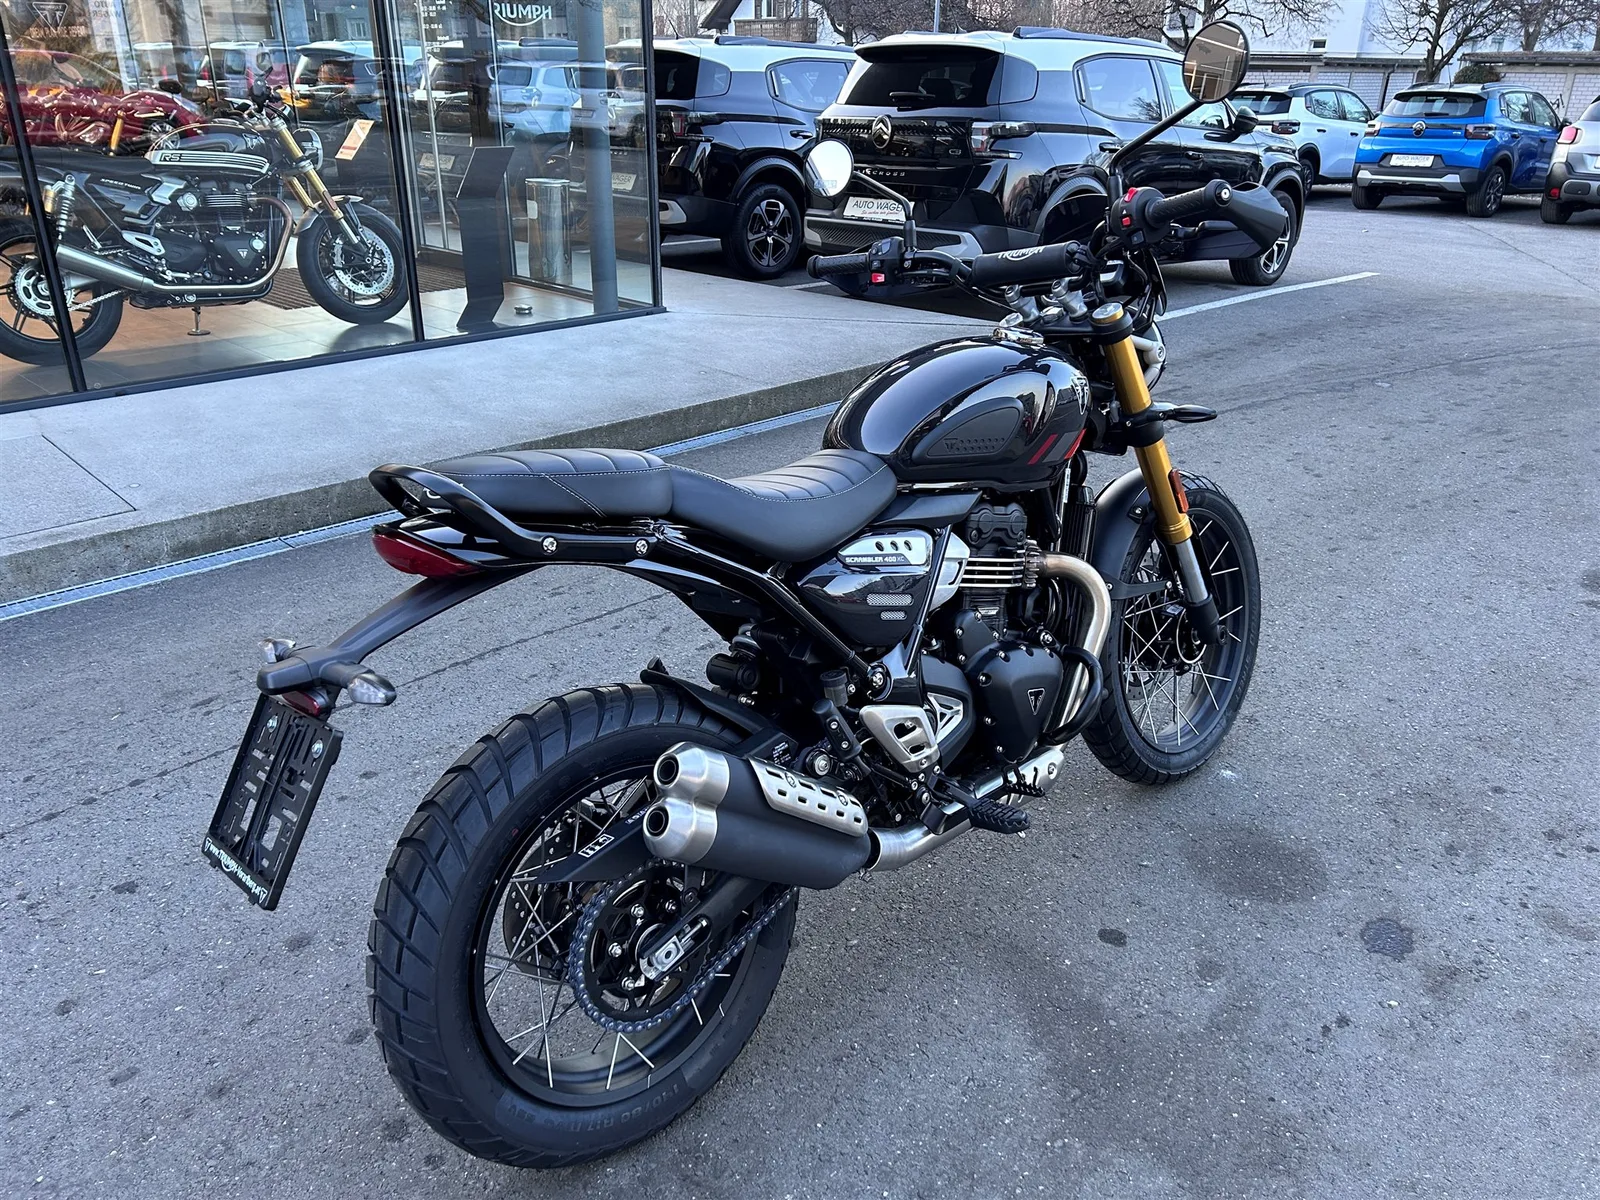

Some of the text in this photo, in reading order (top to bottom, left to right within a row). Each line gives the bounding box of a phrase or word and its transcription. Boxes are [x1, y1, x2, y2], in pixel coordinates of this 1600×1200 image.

[494, 3, 552, 21] RIUMPH
[160, 153, 181, 162] RS
[852, 200, 903, 212] AUTO WÄGE
[998, 246, 1046, 260] TRIUMPH
